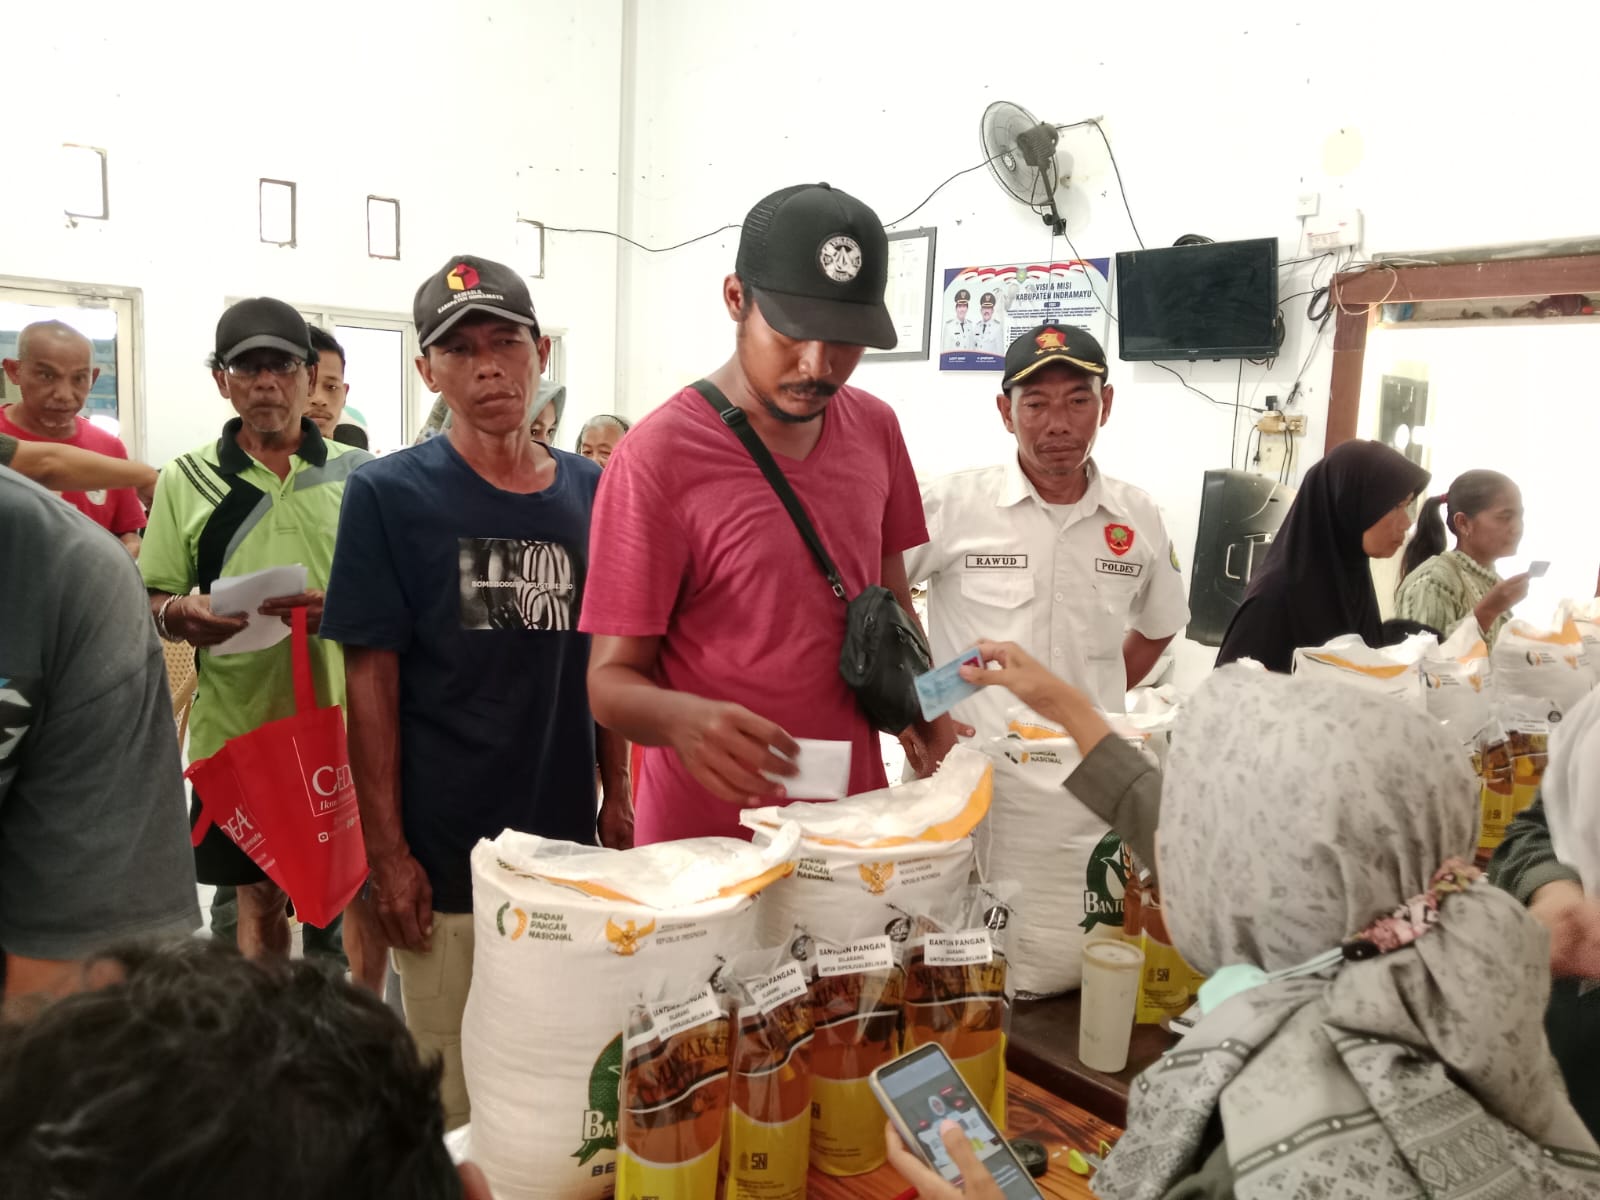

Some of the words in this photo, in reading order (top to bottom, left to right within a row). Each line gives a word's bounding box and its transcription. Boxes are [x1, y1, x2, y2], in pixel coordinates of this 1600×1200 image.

[1035, 283, 1048, 291] VISI
[1057, 282, 1072, 290] MISI
[1016, 292, 1051, 301] KABUPATEN
[1053, 290, 1092, 299] INDRAMAYU
[976, 556, 1018, 566] RAWUD
[1101, 562, 1134, 574] POLDES
[531, 912, 564, 922] BADAN
[530, 921, 568, 931] PANGAN
[528, 930, 574, 942] NASIONAL
[955, 936, 986, 946] PANGAN
[853, 941, 887, 953] PANGAN
[768, 967, 797, 984] PANGAN
